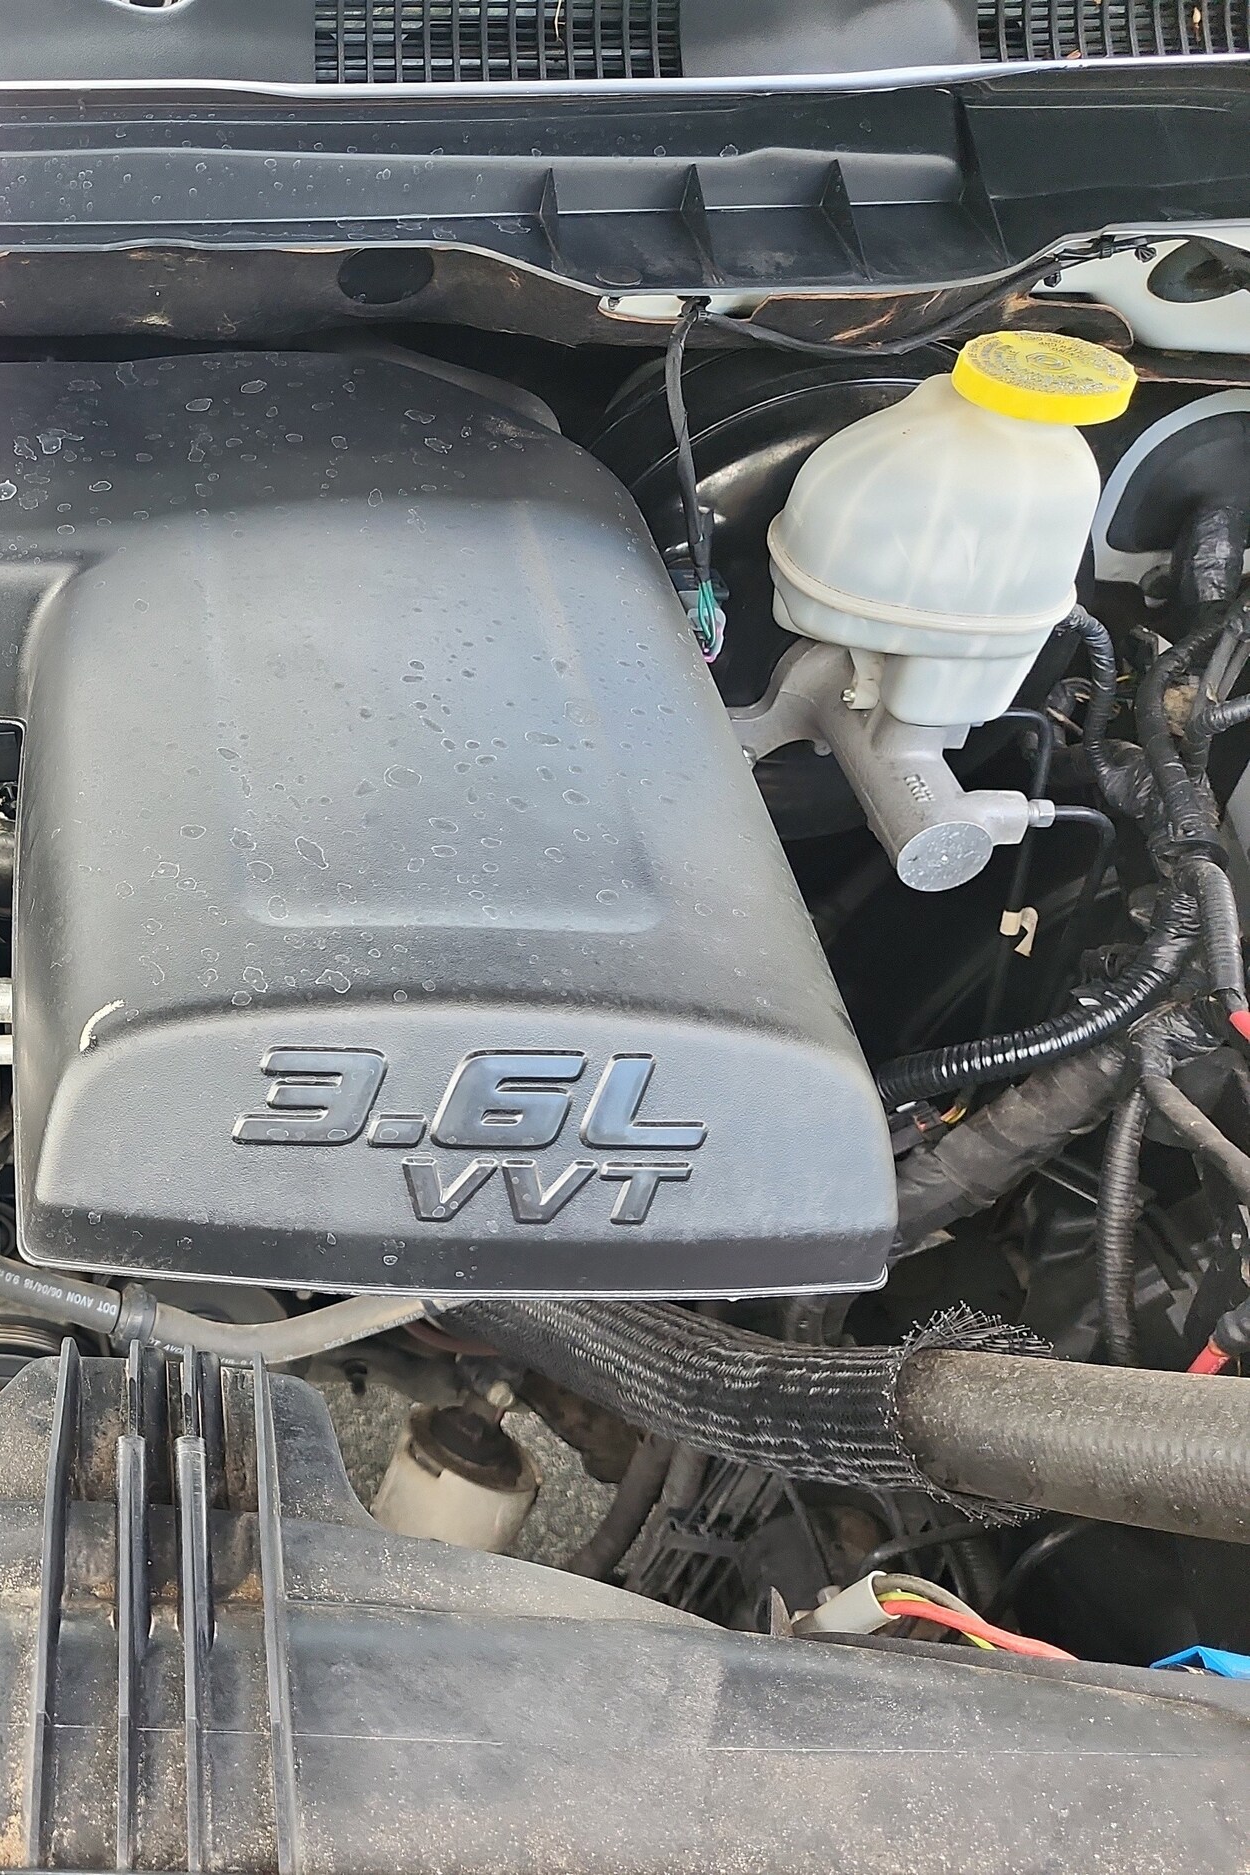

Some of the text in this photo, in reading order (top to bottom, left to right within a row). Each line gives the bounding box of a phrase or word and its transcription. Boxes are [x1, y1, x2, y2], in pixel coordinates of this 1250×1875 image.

[231, 1045, 709, 1150] 3.6L
[402, 1157, 693, 1225] VVT
[66, 1291, 94, 1309] AVON
[96, 1300, 118, 1316] DOT
